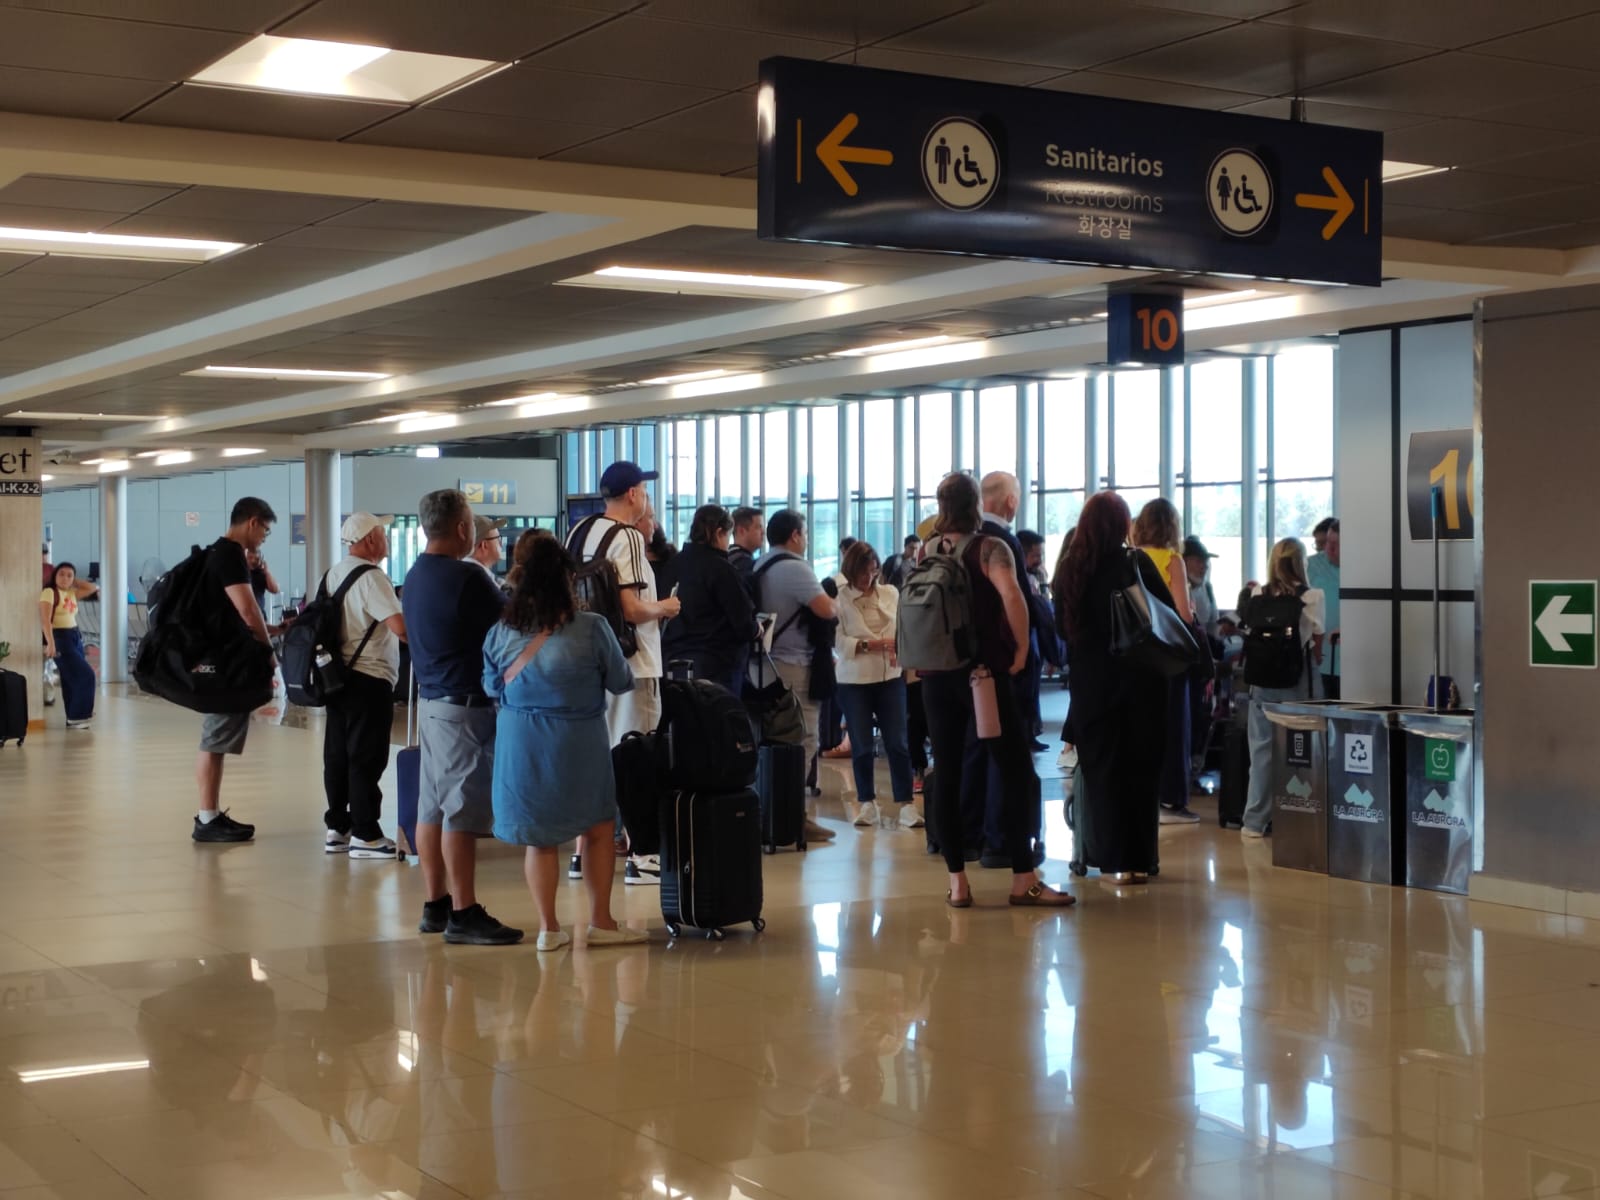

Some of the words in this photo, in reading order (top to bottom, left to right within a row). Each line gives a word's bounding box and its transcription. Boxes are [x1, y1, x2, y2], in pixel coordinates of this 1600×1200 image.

[1045, 143, 1164, 178] Sanitarios
[1078, 214, 1133, 241] 화장실
[1136, 307, 1179, 352] 10
[489, 483, 509, 504] 11
[1411, 811, 1425, 824] LA
